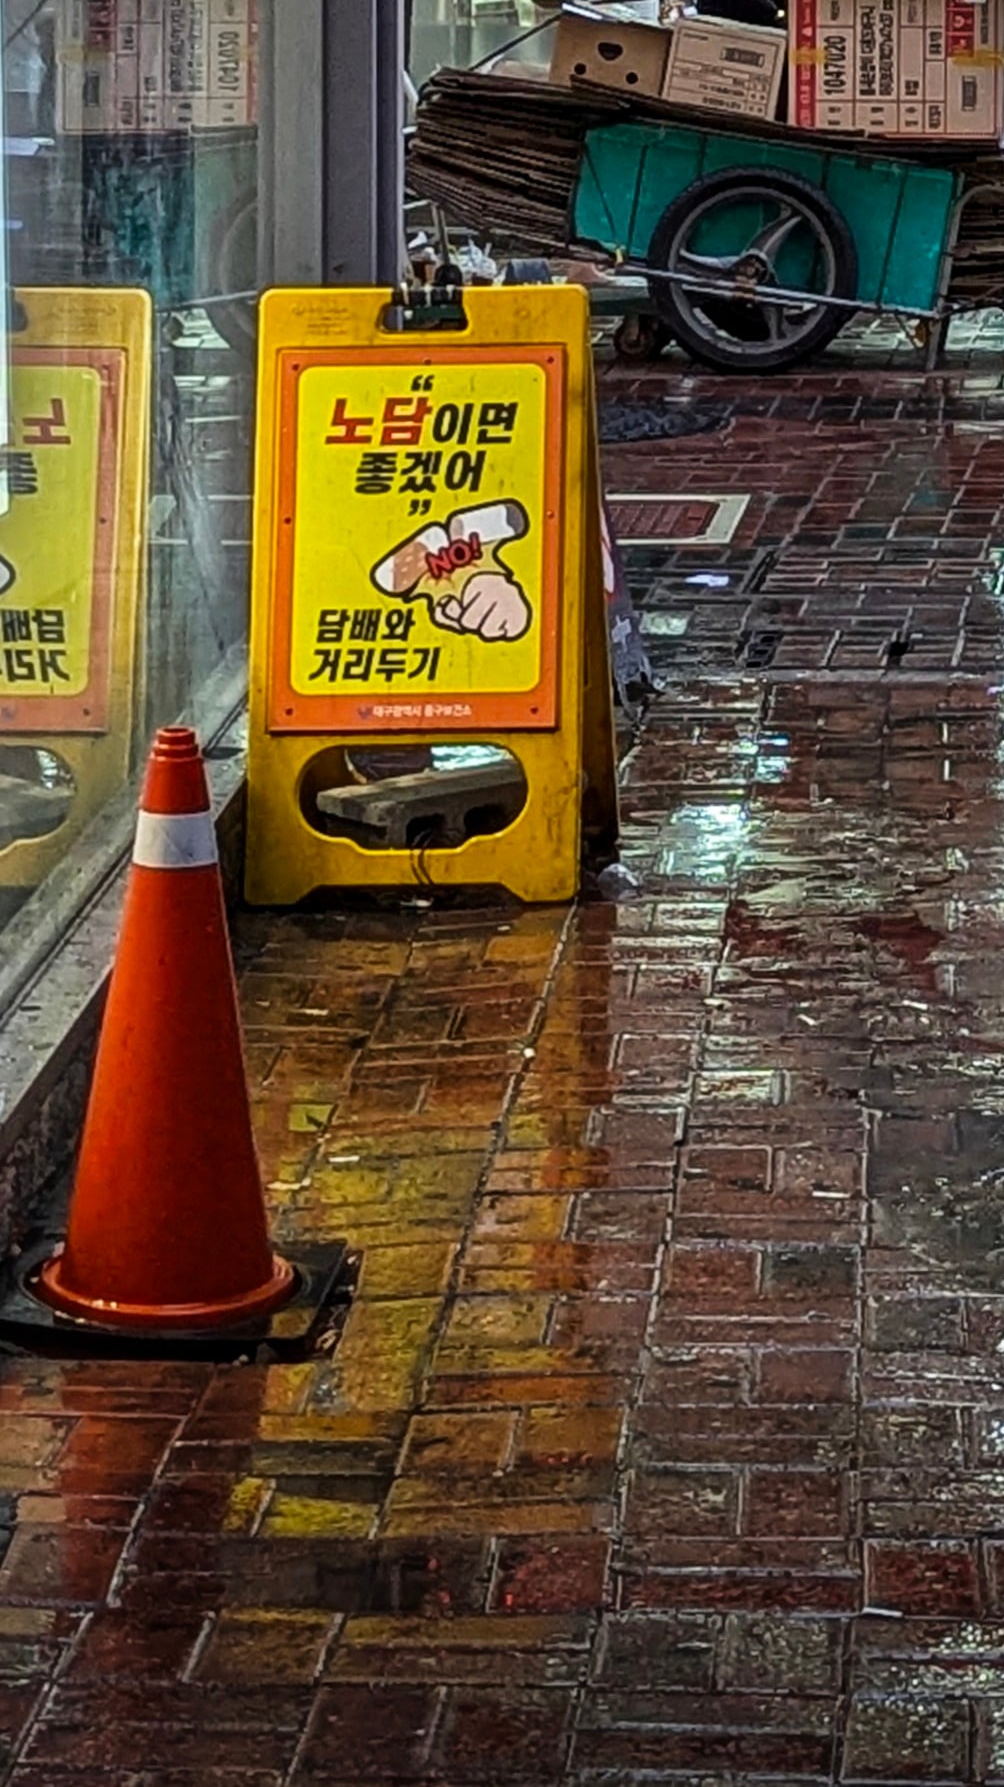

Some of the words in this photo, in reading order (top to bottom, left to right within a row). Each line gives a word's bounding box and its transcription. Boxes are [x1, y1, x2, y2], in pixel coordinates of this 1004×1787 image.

[823, 35, 846, 96] 1047020
[324, 395, 519, 447] 노담이면
[354, 450, 487, 495] 좋겠어
[425, 533, 481, 580] NO!
[316, 608, 416, 645] 담배와
[307, 648, 440, 683] 거리두기
